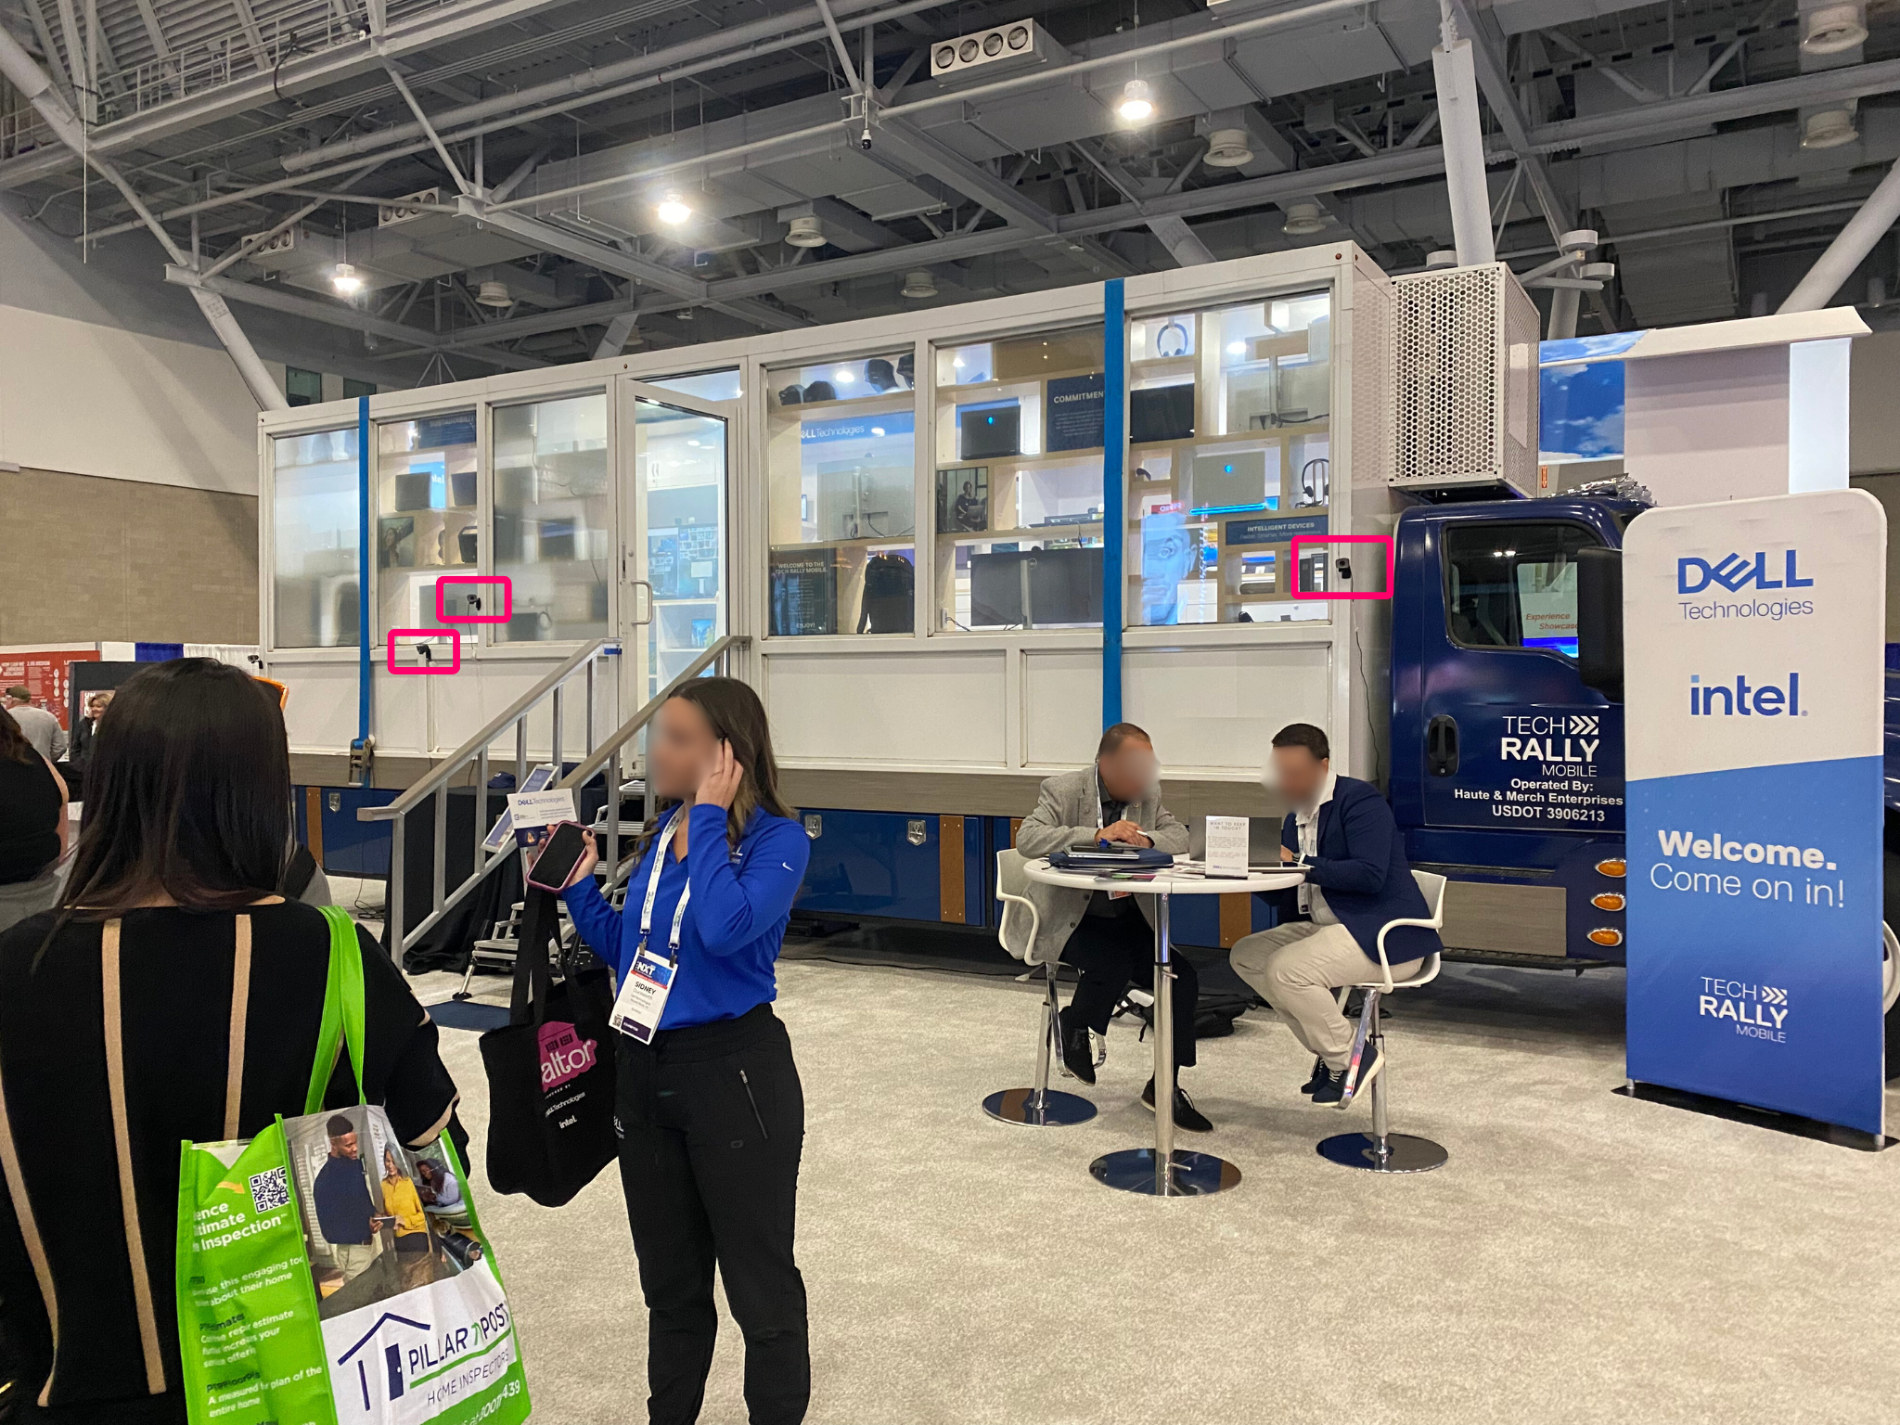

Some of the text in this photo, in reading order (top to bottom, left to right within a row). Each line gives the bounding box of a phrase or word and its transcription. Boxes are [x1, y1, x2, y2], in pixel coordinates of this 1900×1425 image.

[1053, 391, 1104, 404] COMMITMEN
[801, 426, 865, 439] ELL Technologies
[1247, 522, 1315, 532] INTELLIGENT DEVICES
[1677, 549, 1814, 595] DELL
[1525, 613, 1571, 623] Experience
[1678, 598, 1814, 621] Technologies
[1690, 672, 1800, 716] intel
[1502, 715, 1566, 735] TECH
[1501, 737, 1600, 762] RALLY
[1542, 764, 1598, 778] MOBILE
[1511, 778, 1594, 793] Operated By:
[1454, 788, 1624, 806] Haute & Merch Enterprises
[1492, 804, 1606, 822] USDOT 3906213
[1657, 829, 1837, 871] Welcome.
[1650, 862, 1845, 909] Come on in!
[634, 980, 657, 996] SIDNEY
[1700, 976, 1757, 1001] TECH
[1699, 995, 1789, 1029] RALLY
[1736, 1024, 1787, 1044] MOBILE
[541, 1040, 592, 1083] altor
[195, 1212, 246, 1236] timate
[200, 1216, 282, 1251] Inspection
[220, 1278, 239, 1290] this
[241, 1260, 288, 1280] engaging
[240, 1281, 263, 1294] their
[265, 1272, 293, 1287] home
[252, 1310, 294, 1329] estimate
[259, 1327, 280, 1341] your
[408, 1327, 468, 1375] PILLAR
[480, 1302, 510, 1340] POST
[208, 1396, 217, 1406] A
[270, 1376, 291, 1390] plan
[292, 1370, 304, 1382] of
[305, 1366, 323, 1378] the
[502, 1379, 521, 1399] 439
